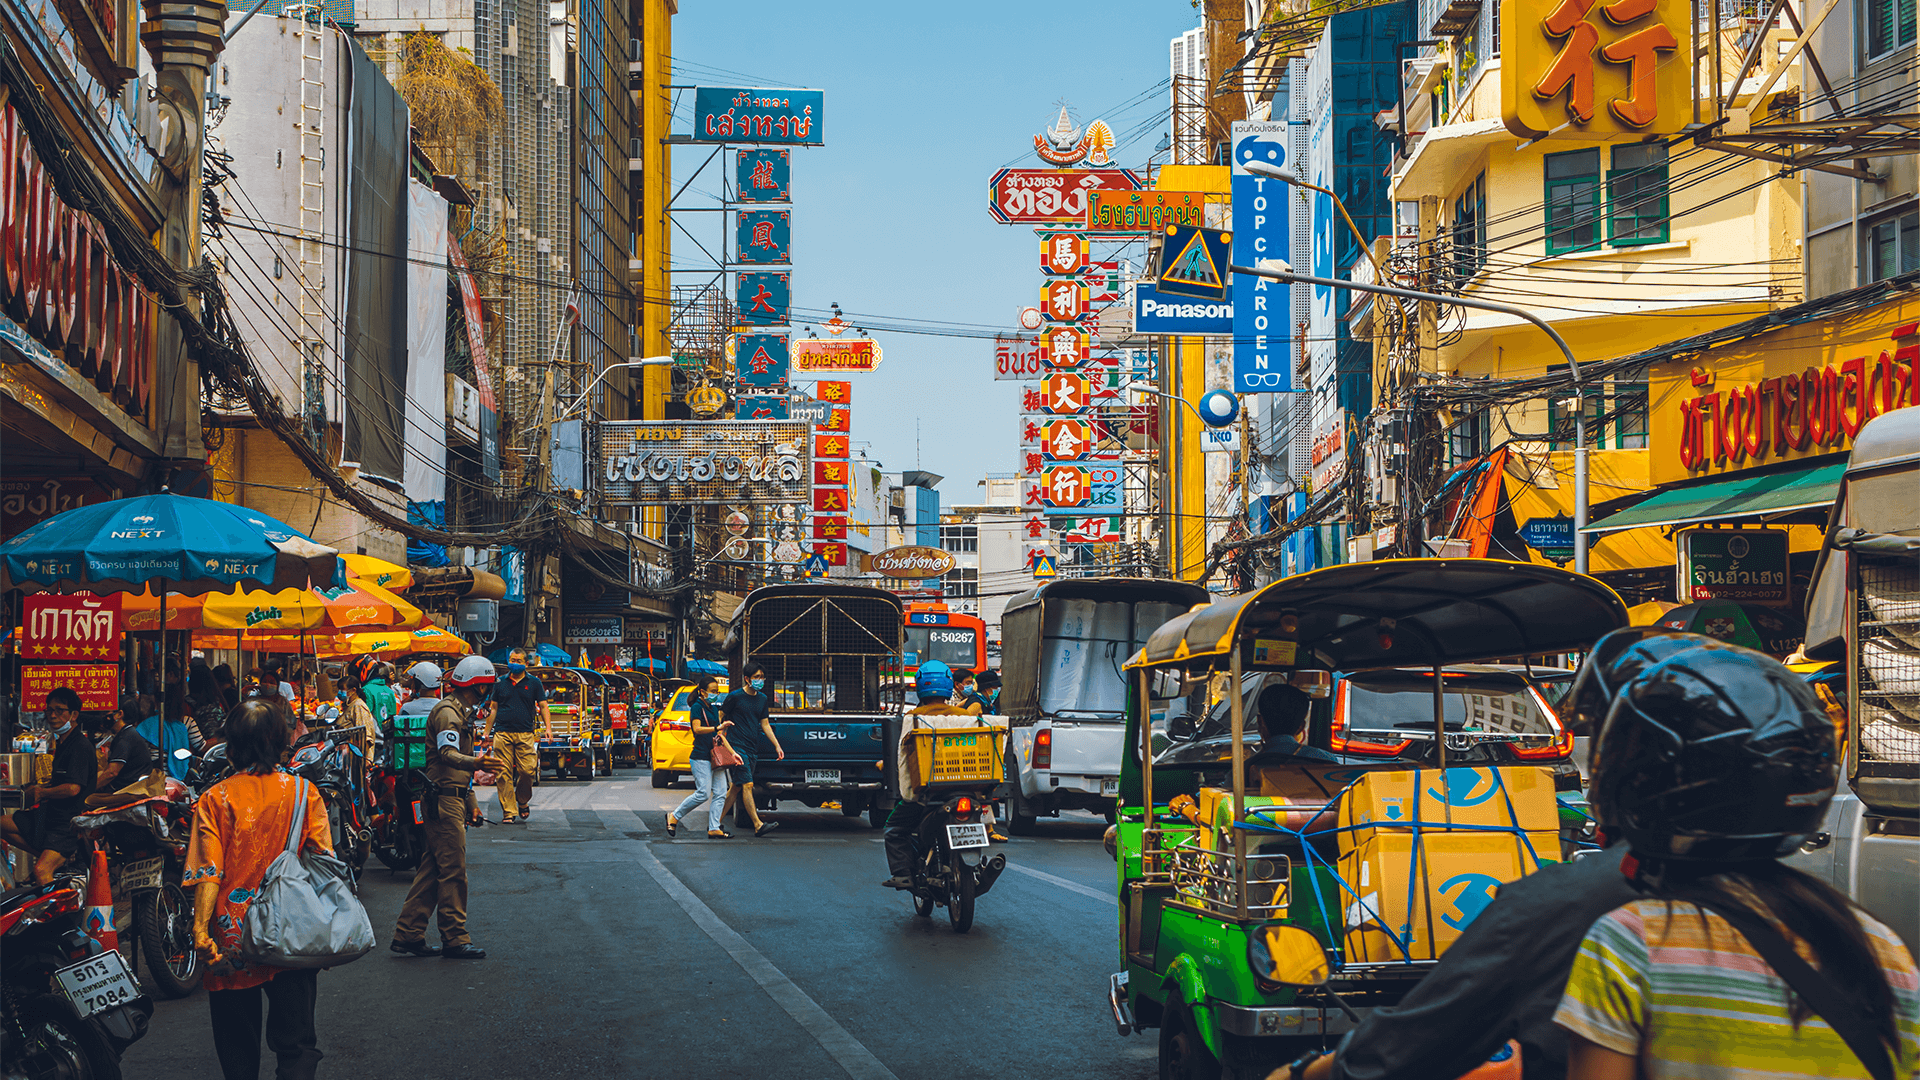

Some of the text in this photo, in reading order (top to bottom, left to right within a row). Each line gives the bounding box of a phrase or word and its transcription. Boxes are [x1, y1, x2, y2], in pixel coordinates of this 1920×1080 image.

[1532, 0, 1679, 128] 行
[732, 92, 790, 108] ห้างทอง
[1005, 174, 1065, 188] ห้างทอง
[1089, 194, 1201, 227] โรงรับจำนำ
[635, 428, 682, 441] ทอง
[110, 530, 166, 539] NEXT
[1530, 523, 1569, 533] เยาวราช
[42, 564, 72, 575] NEXT
[223, 564, 259, 575] NEXT
[1694, 559, 1784, 585] จินฮั้วเฮง
[923, 614, 937, 624] 53
[930, 631, 975, 643] 6-50267
[804, 731, 847, 740] ISUZU
[72, 972, 126, 999] กรุงเทพมหานคร
[84, 986, 128, 1012] 7084
